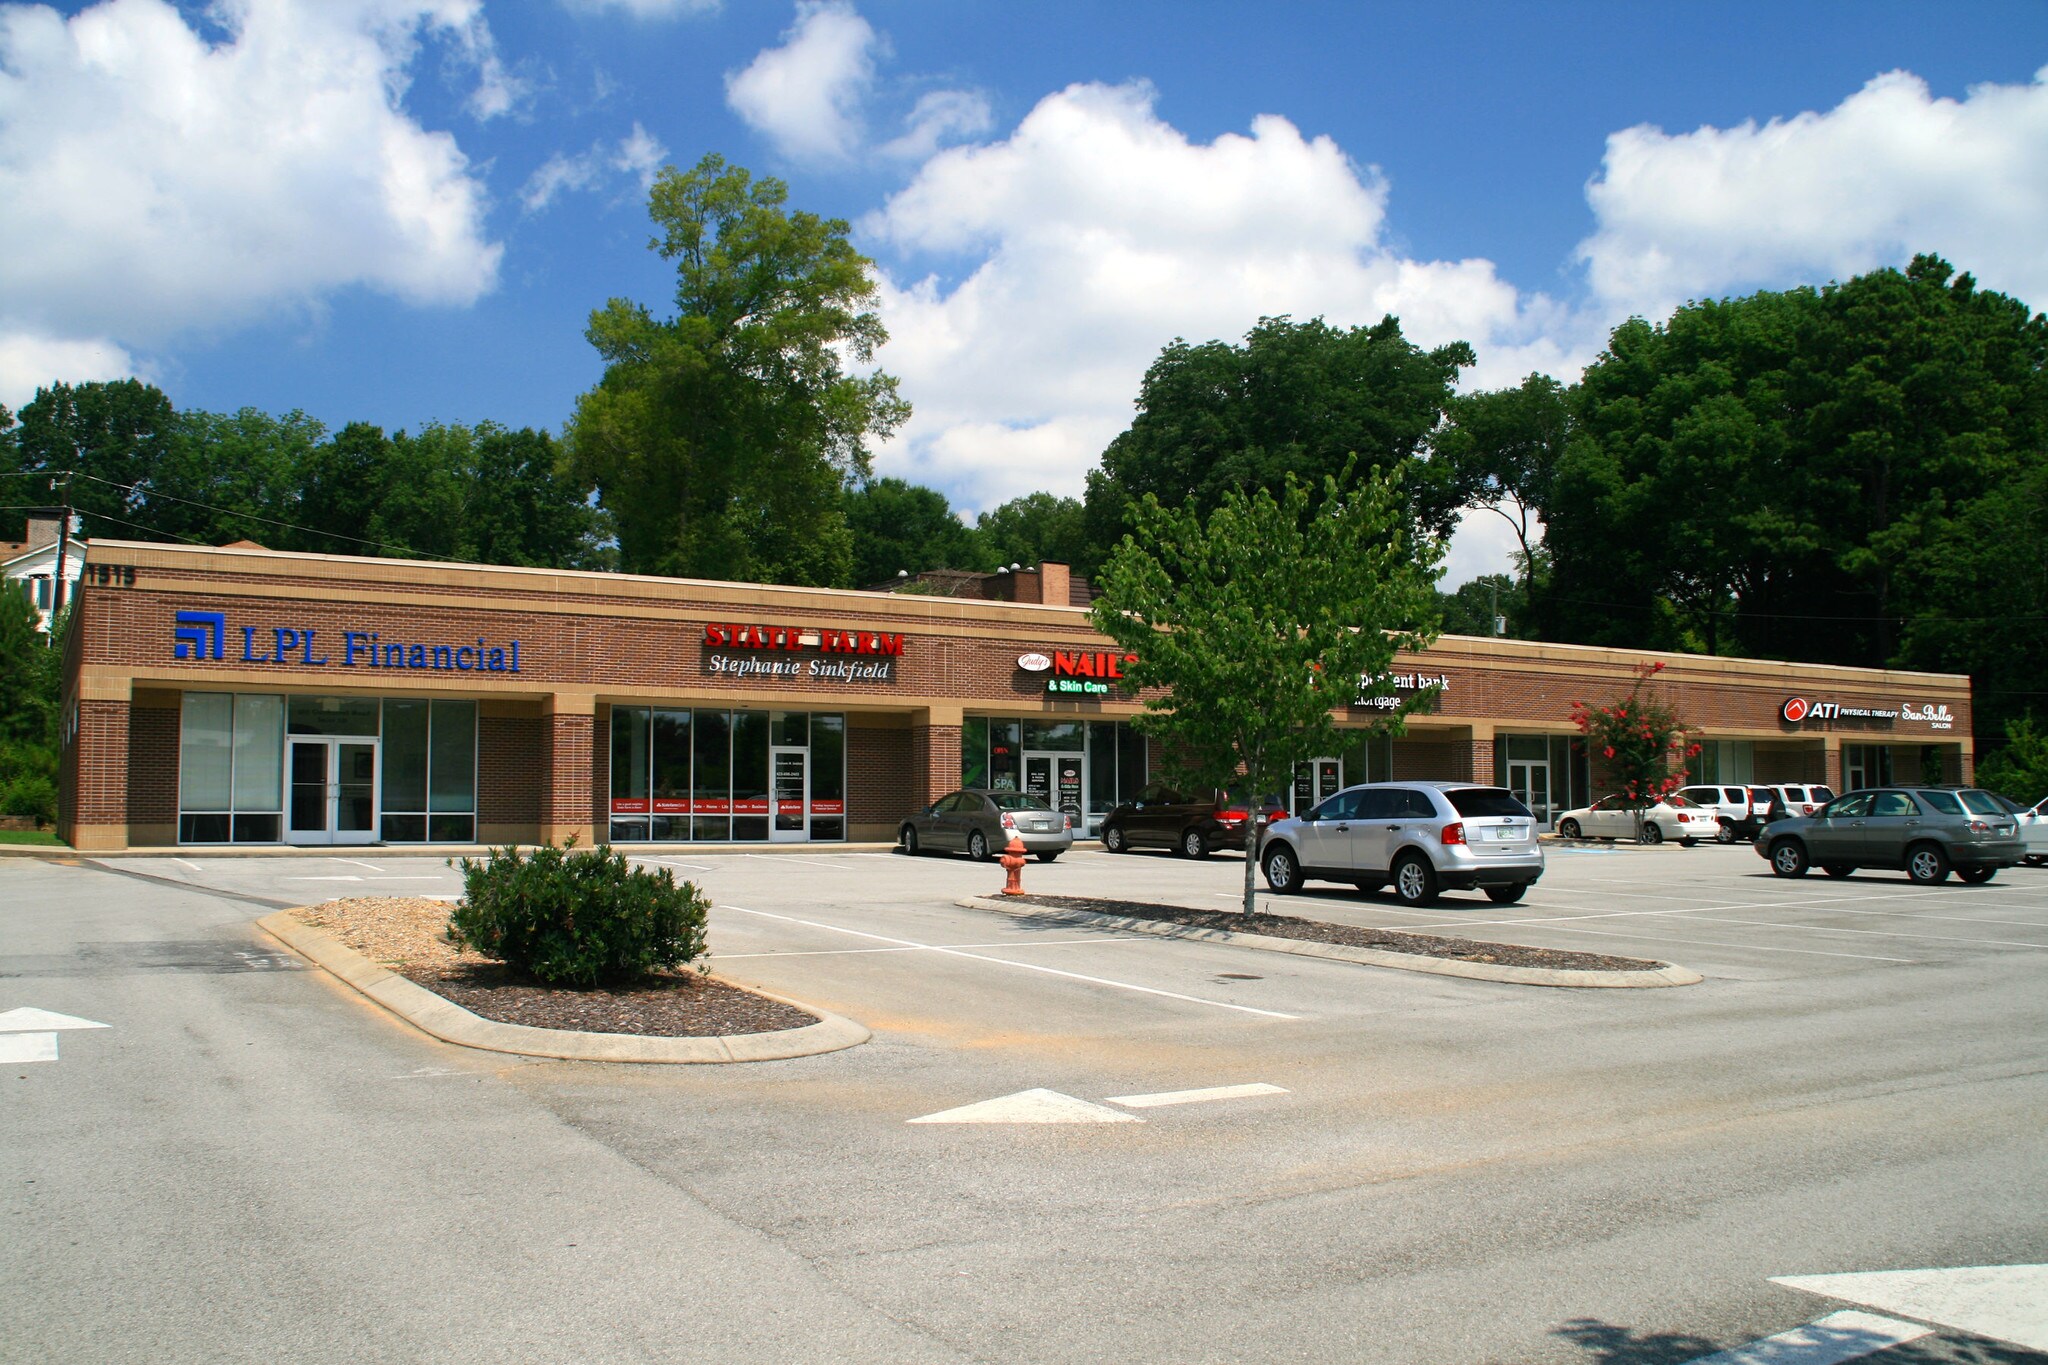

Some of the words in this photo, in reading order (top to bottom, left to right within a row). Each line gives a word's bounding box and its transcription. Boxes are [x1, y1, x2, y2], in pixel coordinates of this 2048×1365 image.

[705, 622, 803, 651] STATE
[819, 629, 905, 657] FARM
[241, 626, 328, 665] LPL
[341, 631, 521, 673] Financial
[709, 654, 800, 677] Stephanie
[808, 659, 890, 683] Sinkfield
[1048, 679, 1057, 691] &
[1059, 680, 1083, 692] Skin
[1084, 681, 1108, 693] Care
[1417, 673, 1450, 691] bank
[1808, 702, 1840, 719] ATI
[1840, 707, 1871, 717] PHYSICAL
[1871, 709, 1899, 718] THERAPY
[994, 778, 1014, 789] SPA
